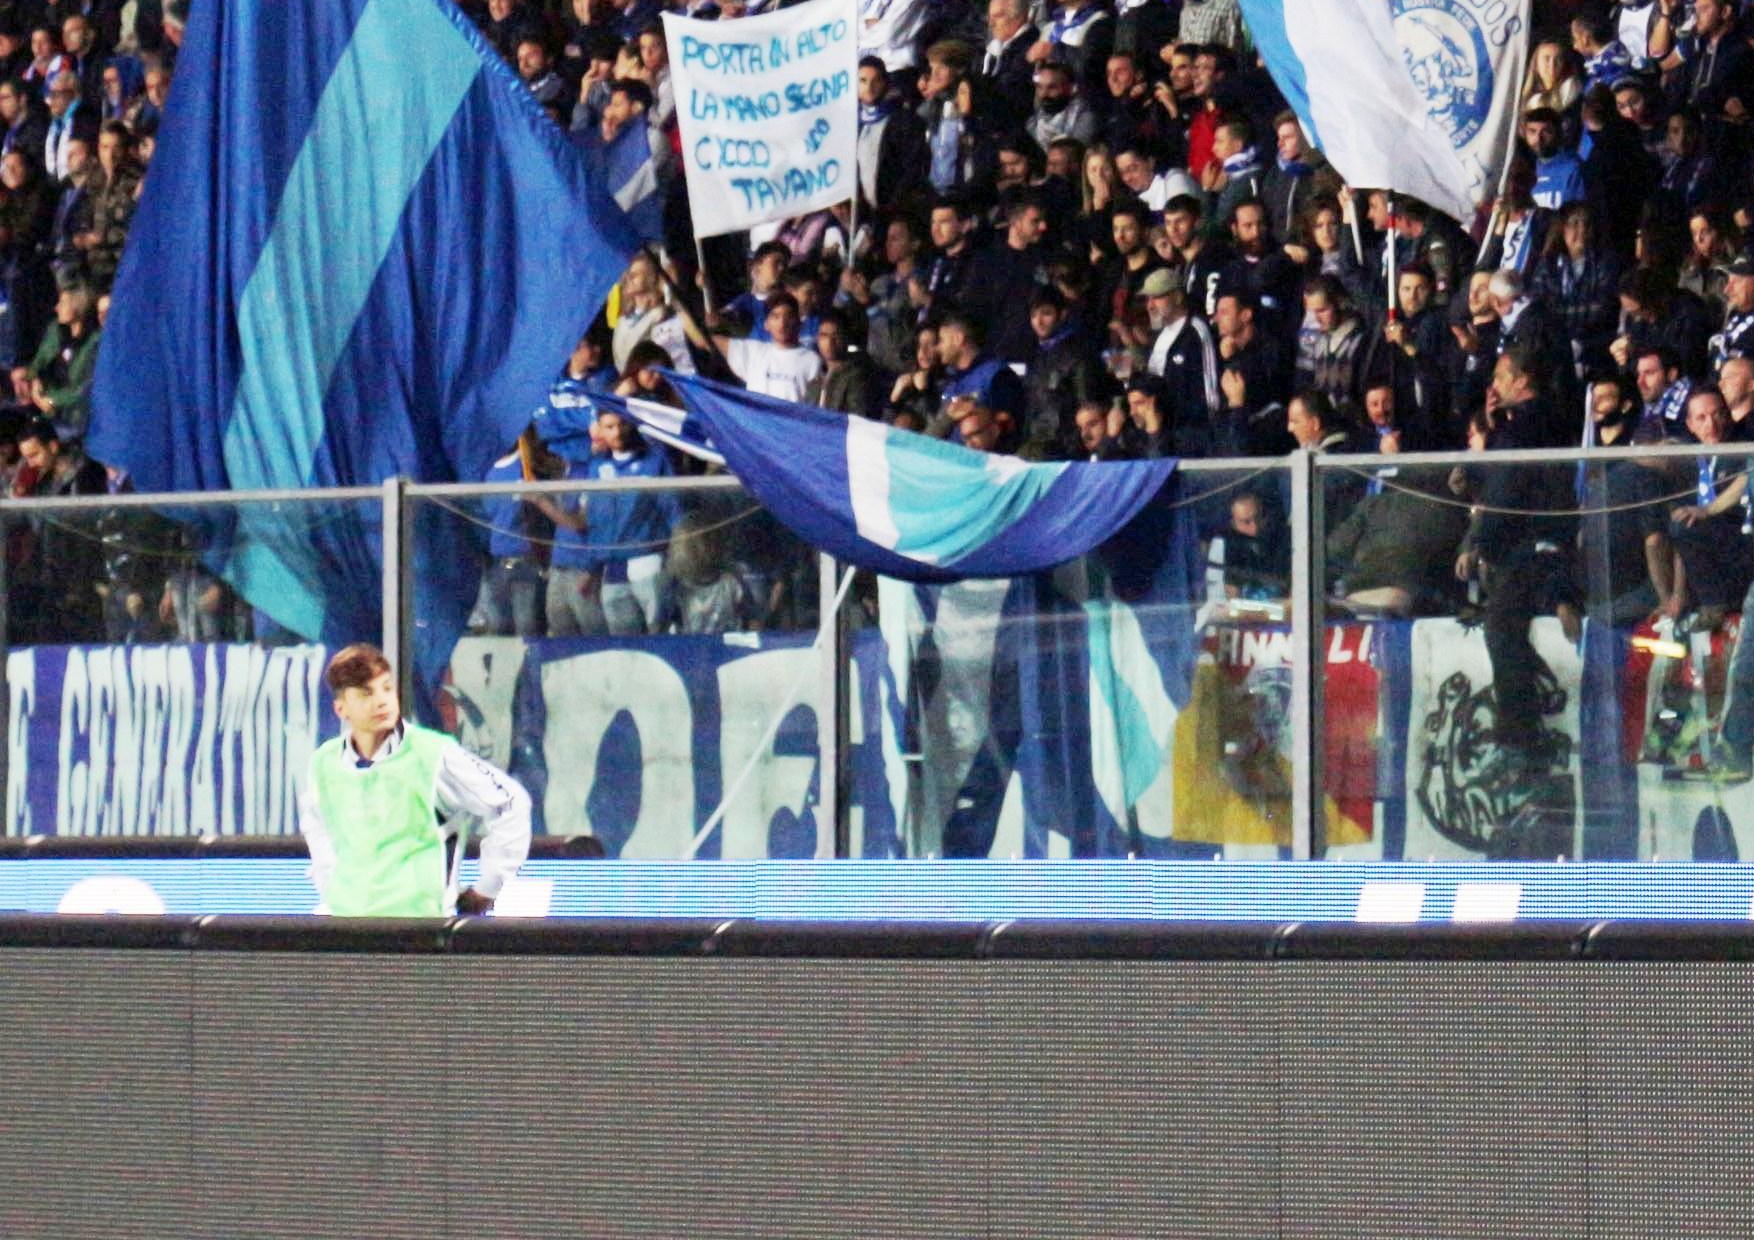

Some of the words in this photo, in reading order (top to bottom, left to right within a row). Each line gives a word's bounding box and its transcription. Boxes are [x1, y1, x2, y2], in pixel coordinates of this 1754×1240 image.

[680, 35, 766, 74] PORTA
[796, 19, 847, 59] ALTO
[691, 88, 718, 121] LA
[723, 91, 780, 122] MANO
[784, 70, 850, 114] SEGNA
[731, 159, 840, 209] TAVANO
